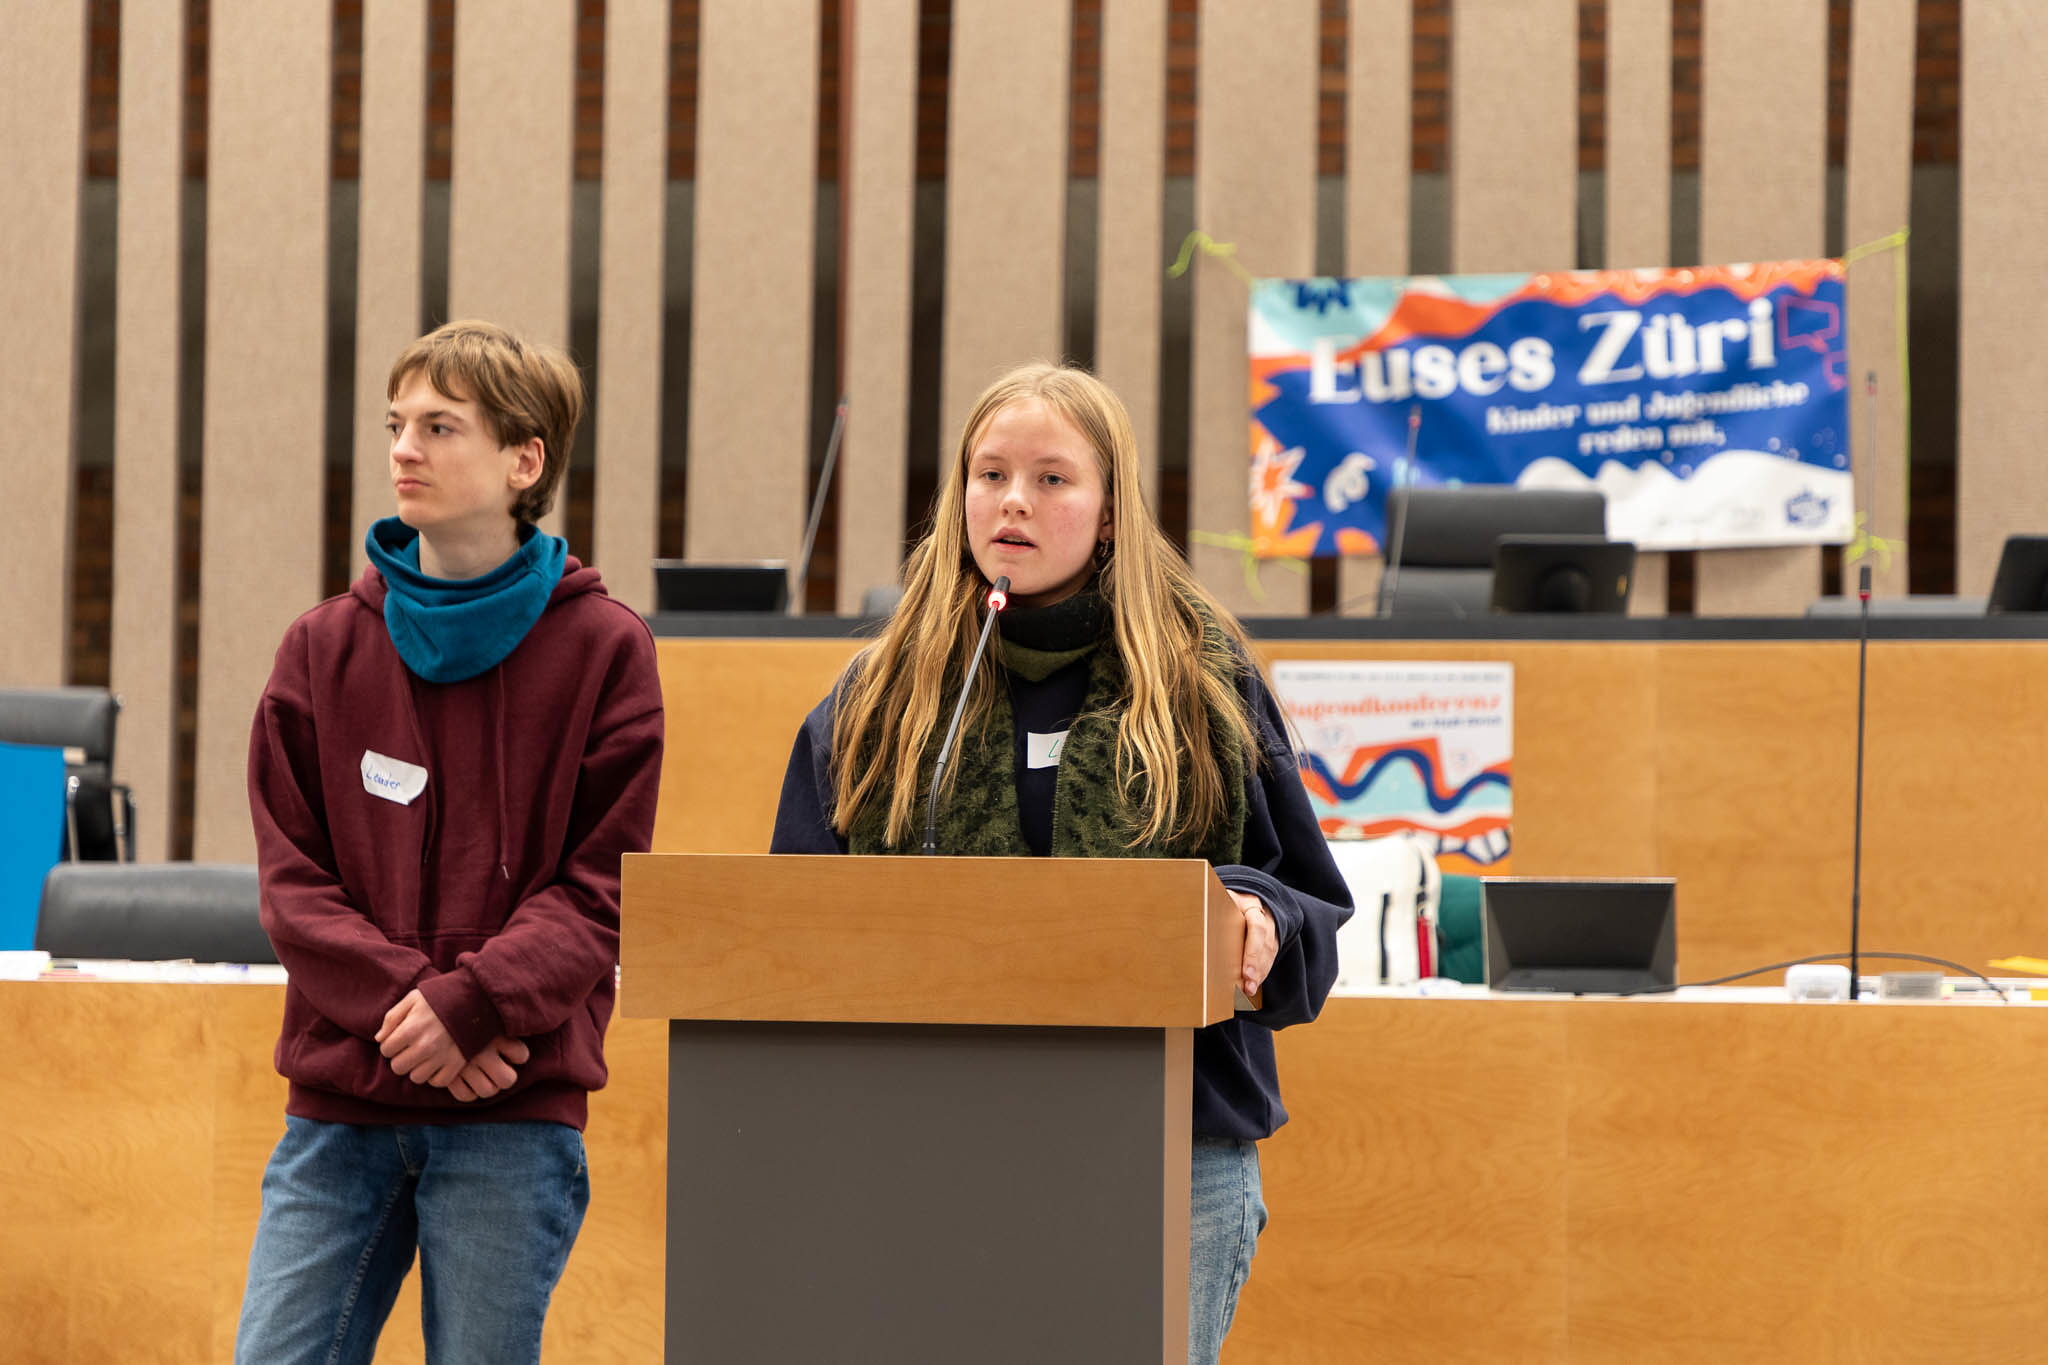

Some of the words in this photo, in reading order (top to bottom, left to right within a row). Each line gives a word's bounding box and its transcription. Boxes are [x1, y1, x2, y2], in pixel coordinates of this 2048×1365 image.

[1309, 336, 1556, 404] Euses
[1577, 297, 1778, 386] Züri
[1486, 402, 1581, 434] Kinder
[1585, 393, 1641, 426] und
[1645, 381, 1810, 420] Jugendliche
[1579, 423, 1664, 454] reden
